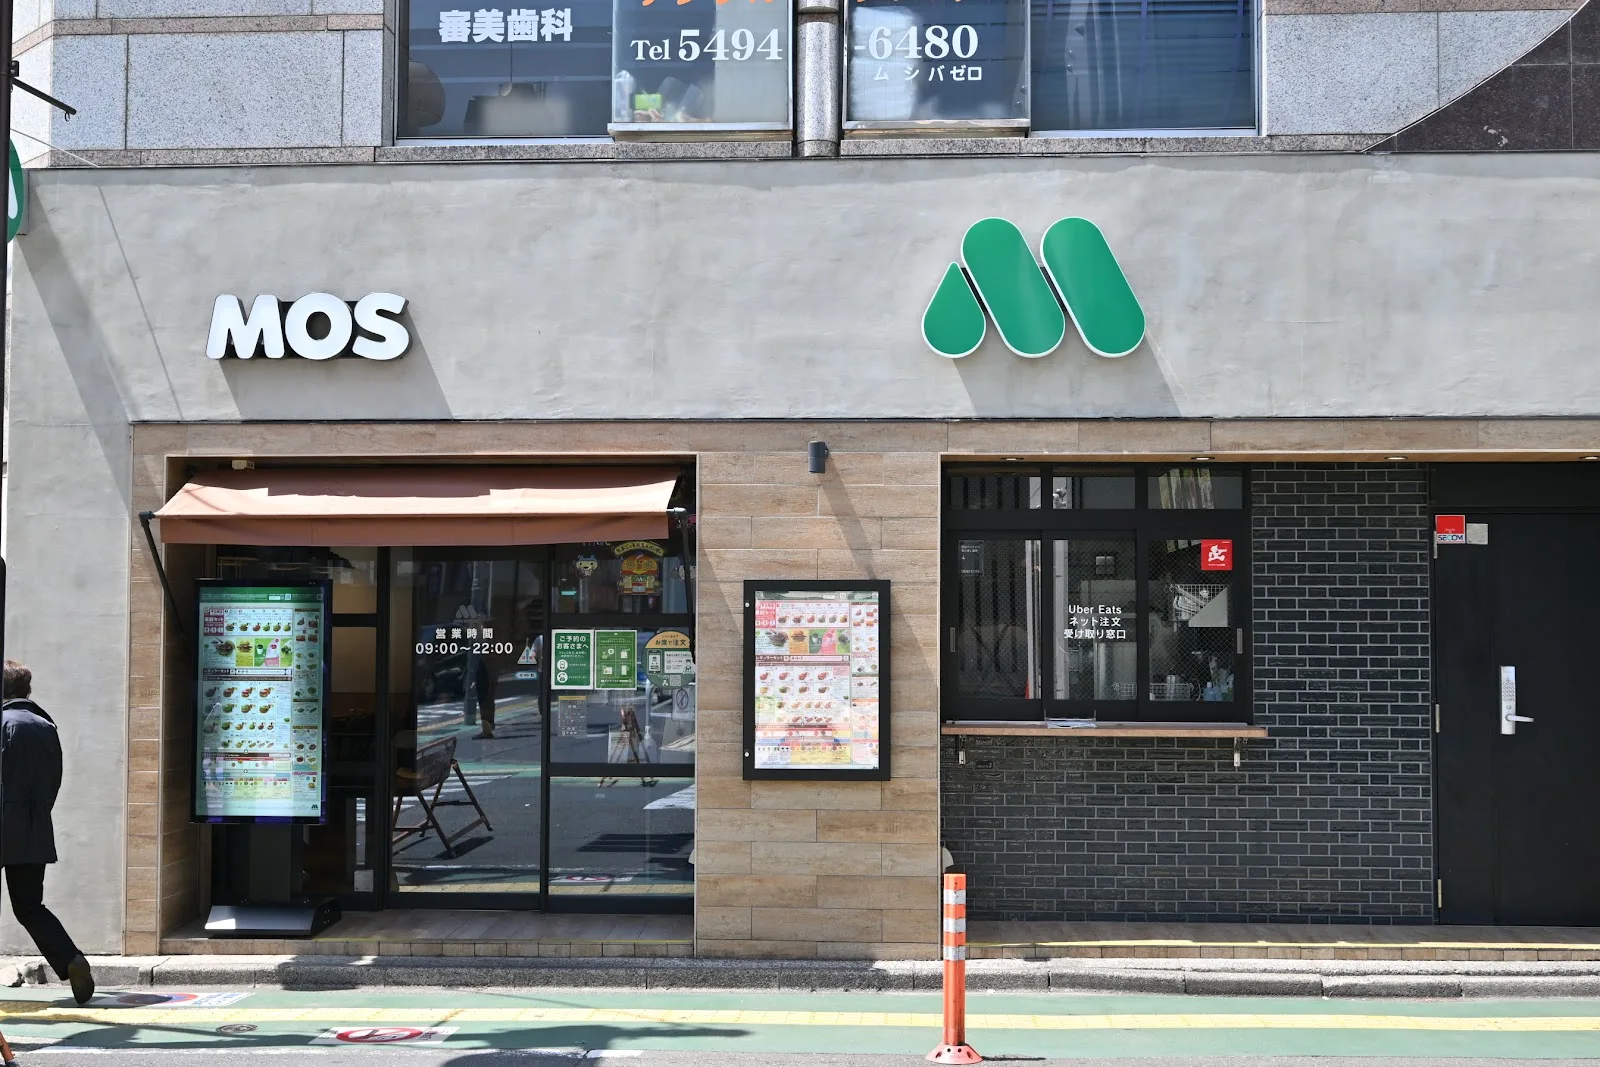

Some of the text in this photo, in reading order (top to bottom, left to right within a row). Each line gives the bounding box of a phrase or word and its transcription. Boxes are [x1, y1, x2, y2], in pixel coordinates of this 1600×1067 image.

[438, 8, 573, 43] 審美歯科
[630, 28, 782, 61] Tel 5494
[854, 25, 978, 60] -6480
[873, 65, 982, 82] ムシバゼロ
[206, 292, 409, 360] MOS
[1068, 605, 1122, 614] Uber Eats
[1069, 616, 1121, 627] ネット注文
[435, 628, 494, 640] 営業時間
[559, 635, 587, 643] ご予約の
[1063, 628, 1126, 639] 受け取り窓口
